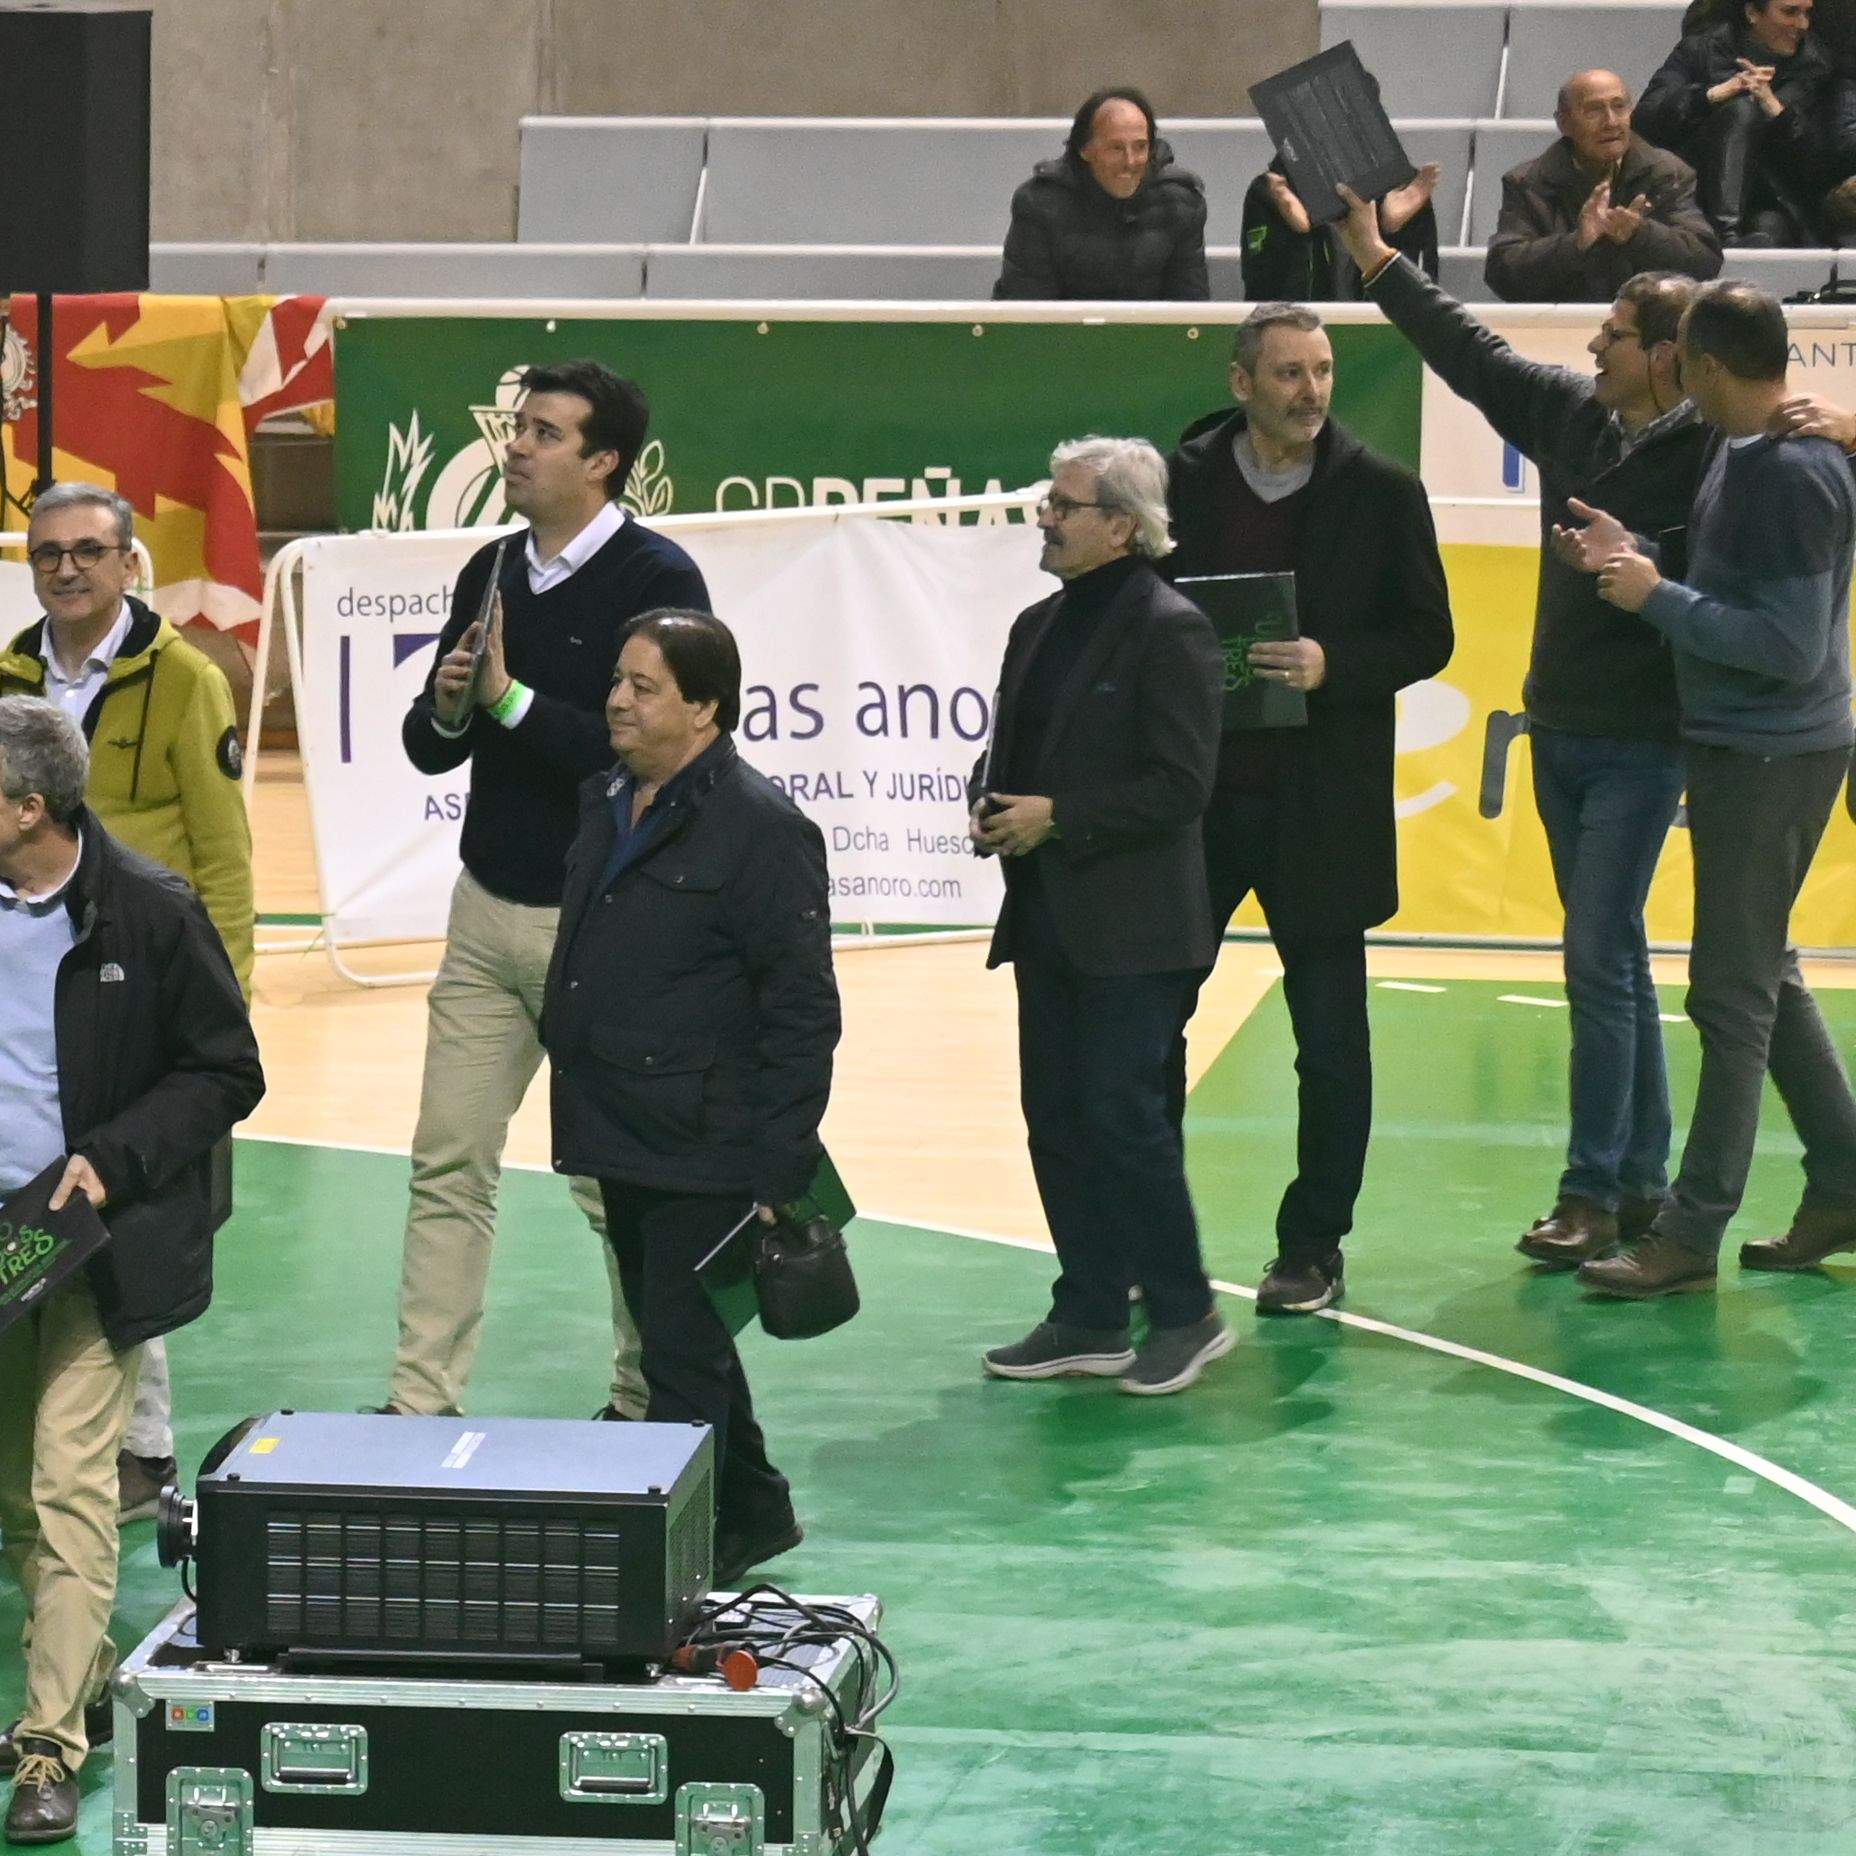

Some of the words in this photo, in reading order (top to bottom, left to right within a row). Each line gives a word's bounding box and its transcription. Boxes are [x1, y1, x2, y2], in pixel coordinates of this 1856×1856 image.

[425, 791, 471, 821] AS
[862, 769, 878, 799] Y
[832, 826, 889, 851] Dcha
